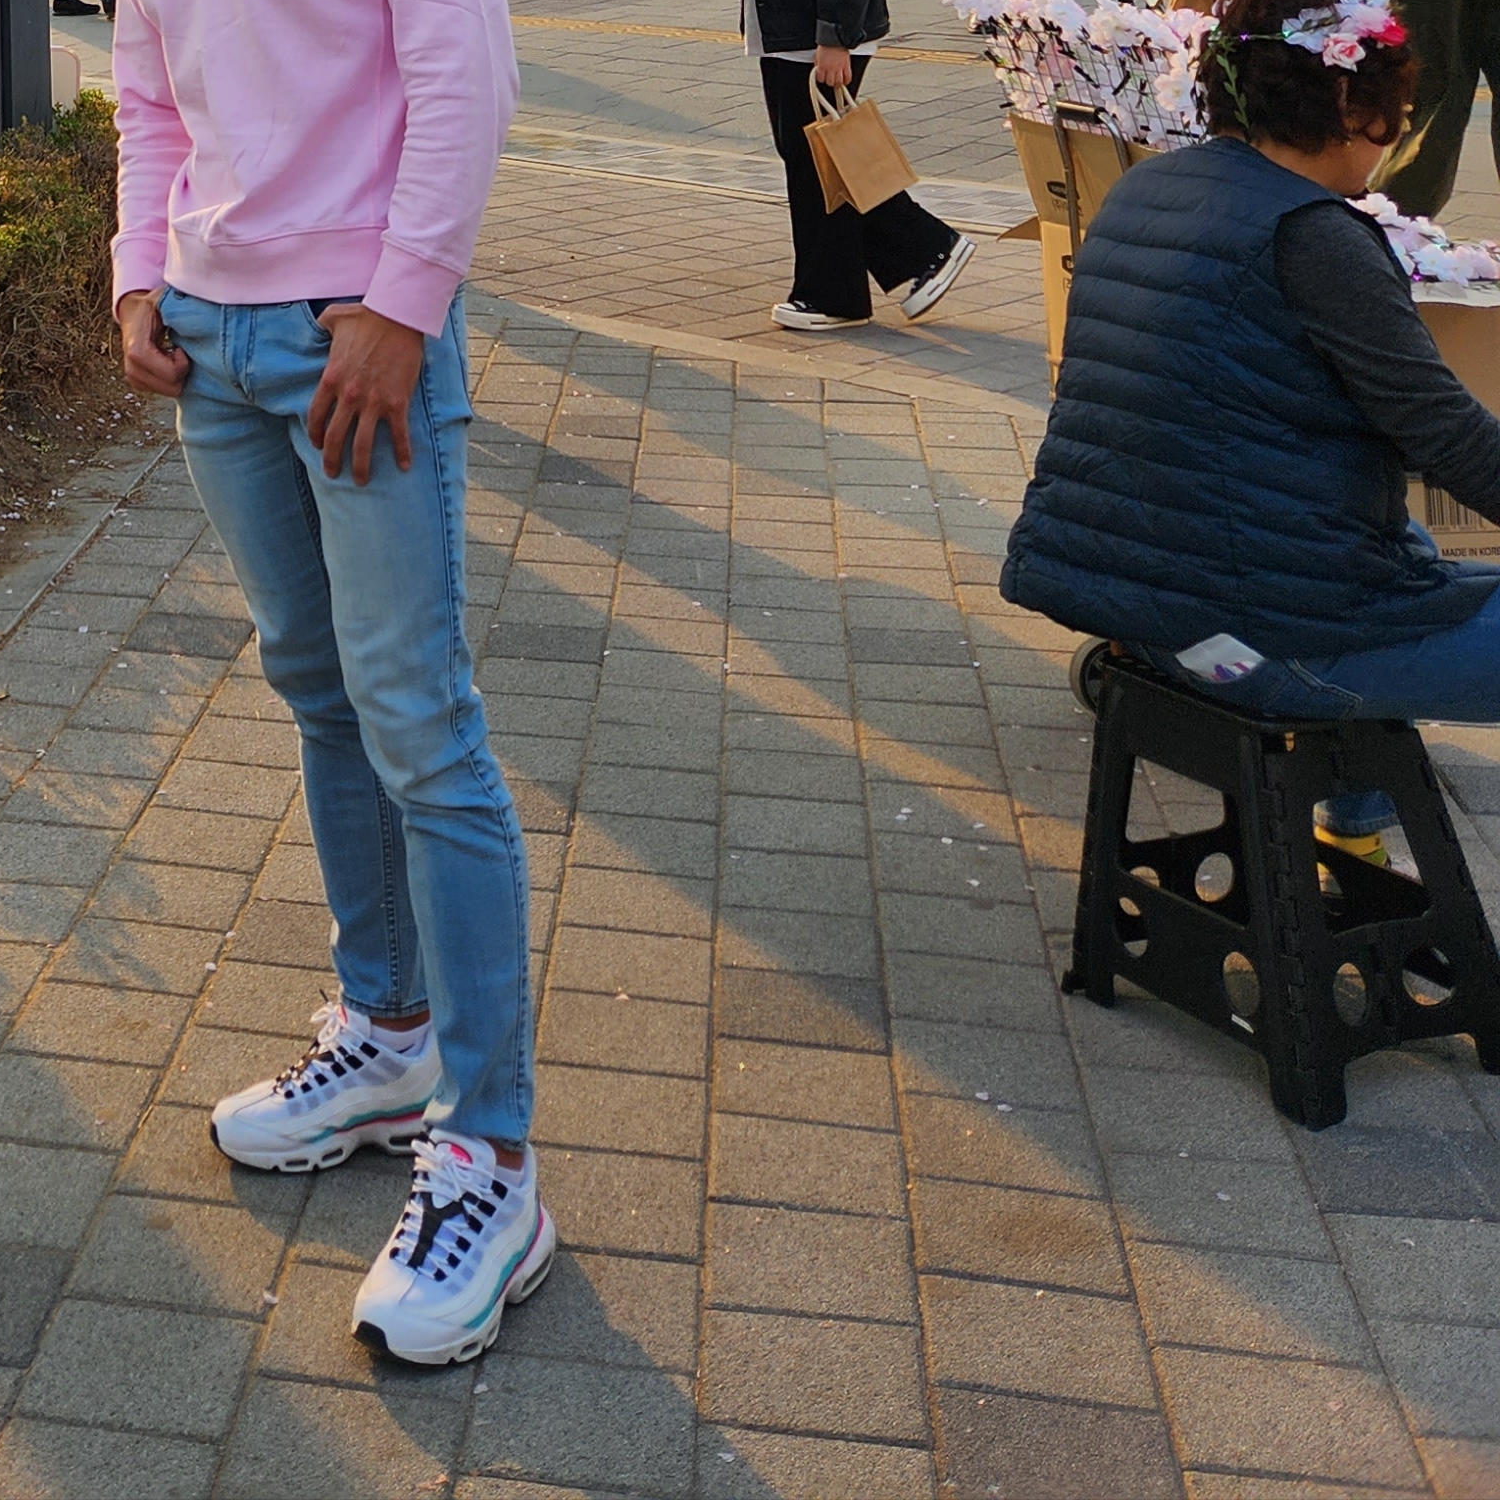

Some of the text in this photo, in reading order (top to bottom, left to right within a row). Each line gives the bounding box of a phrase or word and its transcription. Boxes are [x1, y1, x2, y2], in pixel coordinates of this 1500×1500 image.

[1442, 547, 1500, 556] MADE IN KORE
